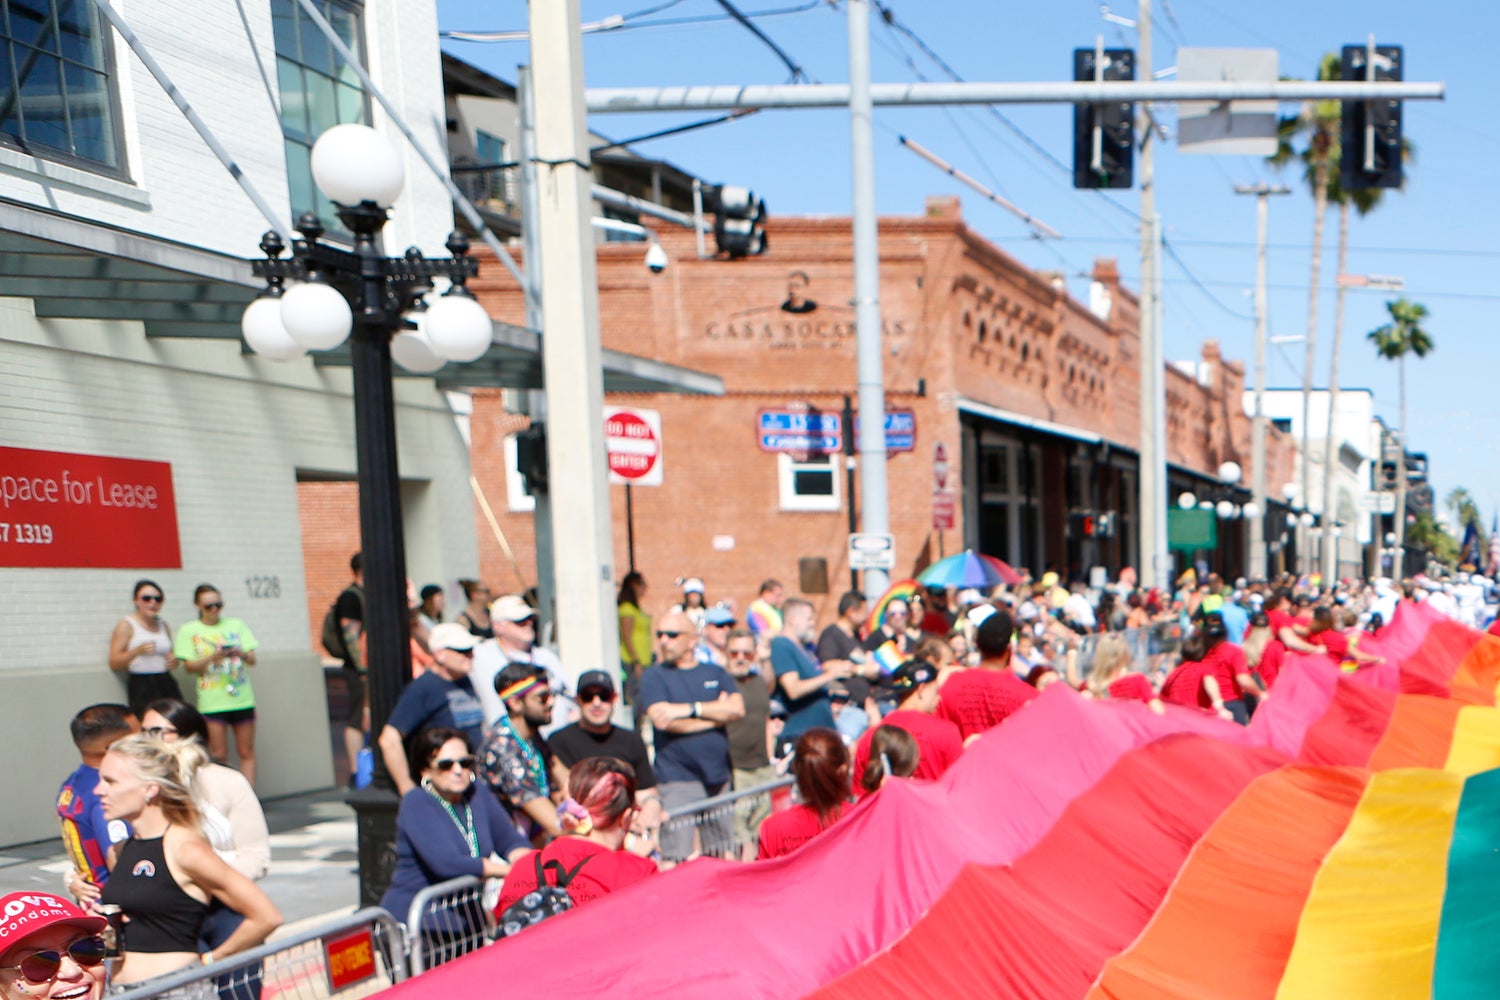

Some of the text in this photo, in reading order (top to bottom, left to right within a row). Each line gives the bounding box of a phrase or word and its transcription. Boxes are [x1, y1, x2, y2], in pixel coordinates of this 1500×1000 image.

[705, 322, 773, 339] CASA
[625, 422, 650, 438] NOT
[609, 455, 649, 471] ENTER
[62, 470, 94, 504] for
[97, 476, 158, 509] Lease
[15, 523, 54, 544] 1319
[245, 575, 282, 598] 1228
